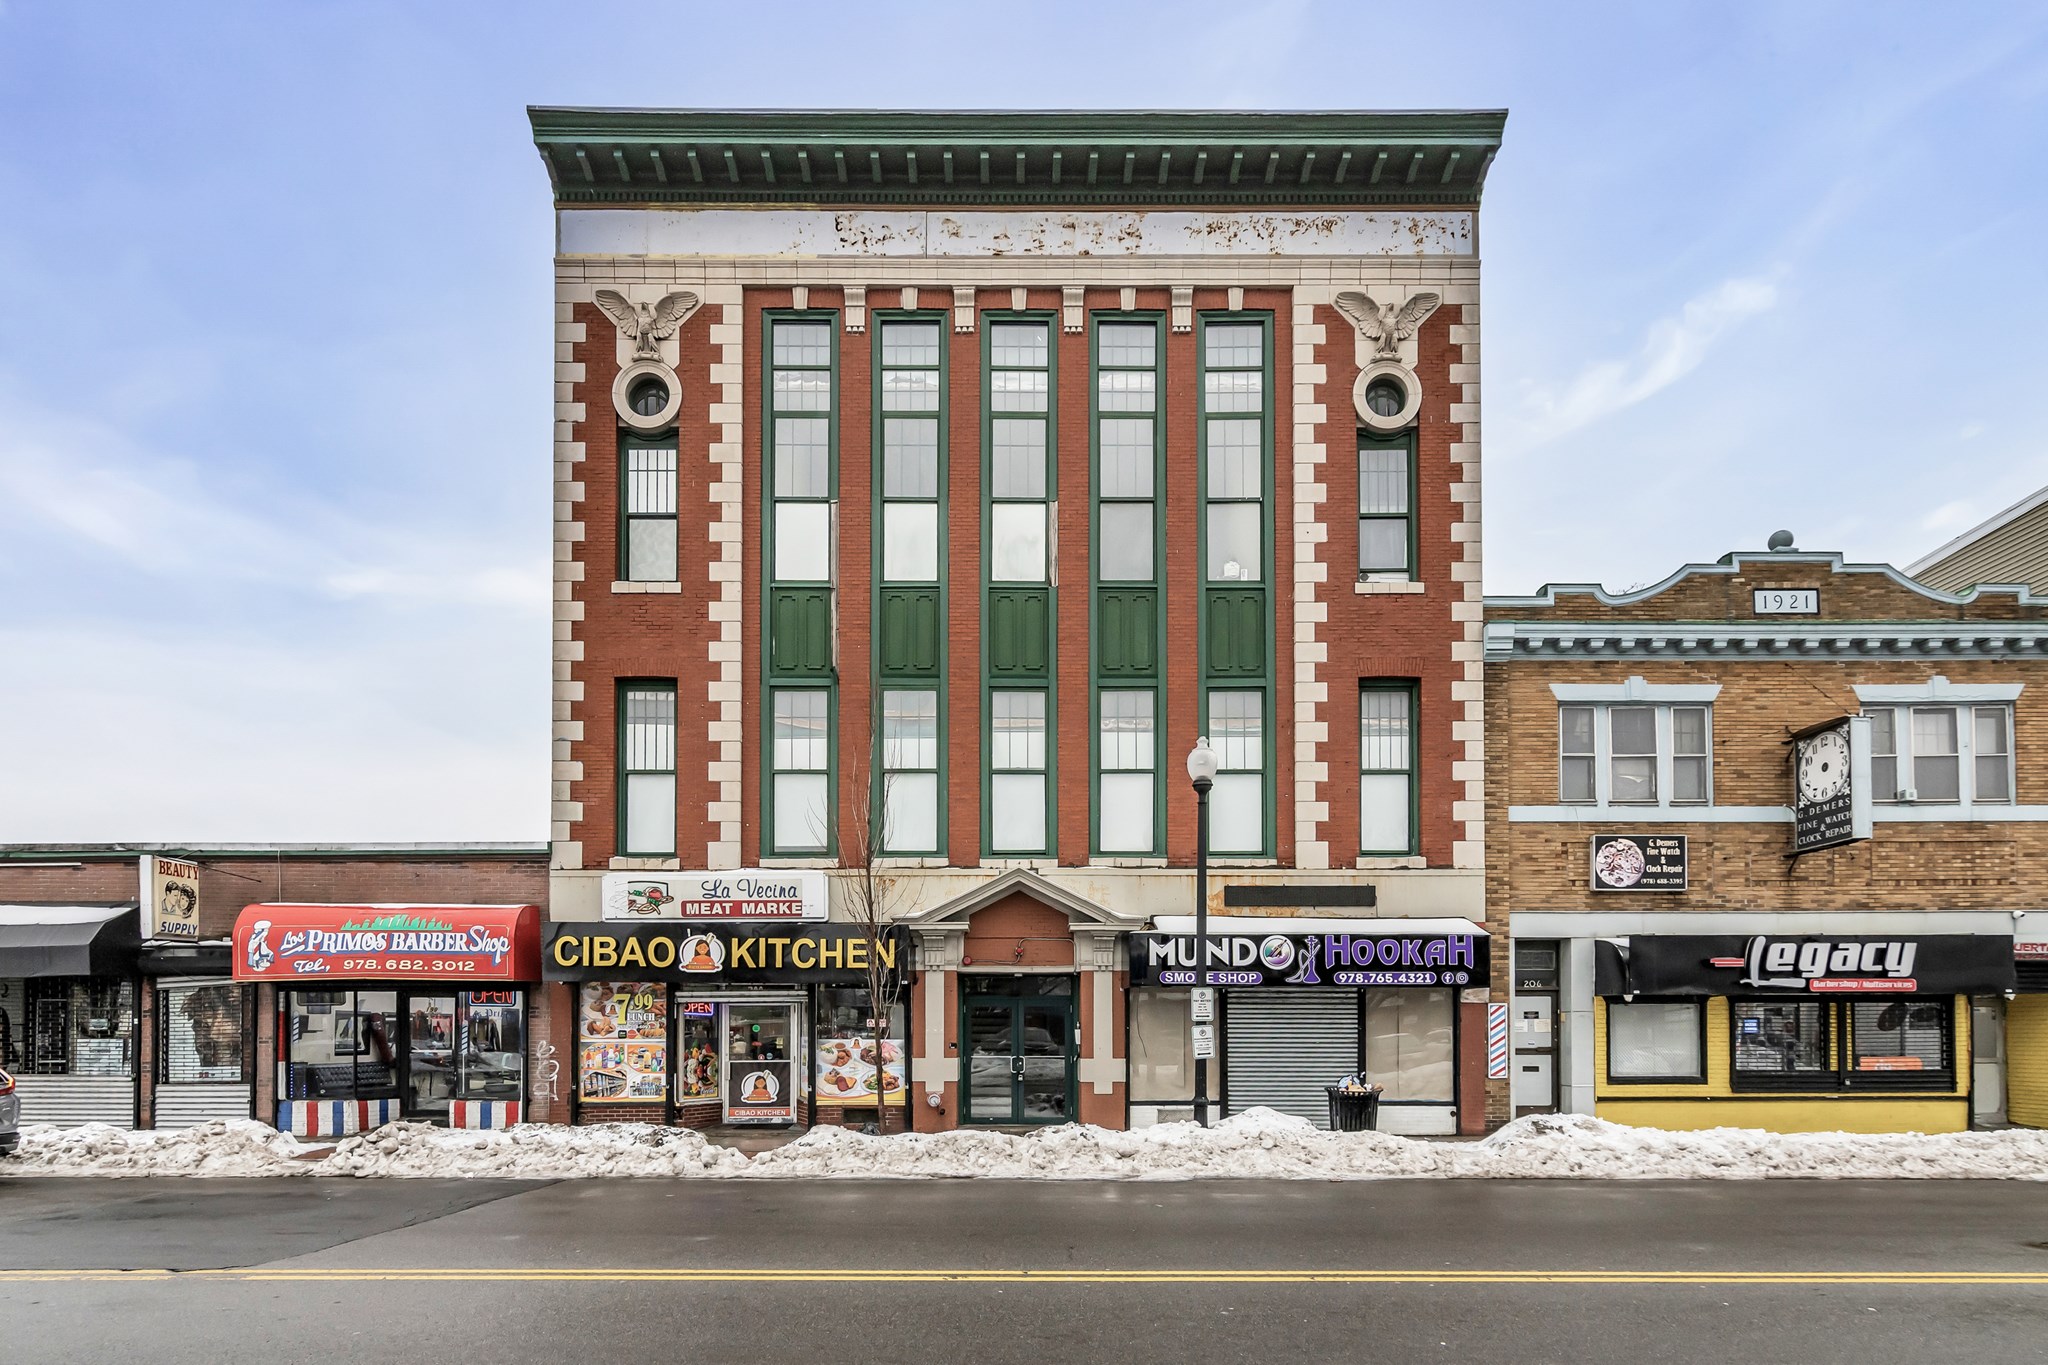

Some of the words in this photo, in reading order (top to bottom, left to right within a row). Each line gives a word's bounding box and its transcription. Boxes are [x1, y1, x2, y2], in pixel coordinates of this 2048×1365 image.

[1763, 594, 1808, 609] 1921
[1820, 735, 1828, 748] 12
[1833, 736, 1837, 747] 1
[1812, 743, 1818, 755] 11
[1839, 743, 1845, 754] 2
[1804, 755, 1813, 767] 10
[1841, 755, 1848, 766] 3
[1801, 769, 1808, 781] 9
[1839, 769, 1845, 779] 4
[1805, 780, 1811, 791] 8
[1831, 781, 1837, 792] 5
[1812, 787, 1818, 798] 7
[1821, 787, 1828, 798] 6
[1809, 797, 1851, 816] DEMERS
[1798, 819, 1818, 832] FINE
[1825, 810, 1852, 824] WATCH
[1820, 823, 1826, 832] &
[1798, 832, 1822, 845] CLOCK
[1825, 824, 1852, 839] REPAIR
[1656, 838, 1679, 847] Demers
[1646, 847, 1660, 856] Fine
[1660, 847, 1681, 856] Watch
[1660, 856, 1667, 864] &
[158, 860, 199, 880] BEAUTY
[1646, 864, 1662, 873] Clock
[1662, 864, 1684, 874] Repair
[701, 879, 731, 899] La
[736, 878, 798, 899] Vecina
[686, 902, 733, 915] MEAT
[161, 921, 198, 935] SUPPLY
[280, 931, 306, 953] Los
[304, 929, 388, 954] PRIMOS
[389, 932, 470, 952] BARBER
[469, 925, 511, 964] Shop
[554, 935, 676, 968] CIBAO
[731, 937, 895, 969] KITCHEN
[1325, 934, 1474, 970] HOOKAH
[1740, 936, 1918, 987] Legacy
[1165, 973, 1214, 983] SMOE
[1218, 973, 1257, 983] SHOP
[1339, 972, 1431, 983] 978.765.4321
[1523, 980, 1542, 988] 206
[626, 1012, 656, 1022] LUNCH
[757, 1108, 787, 1116] KITCHEN
